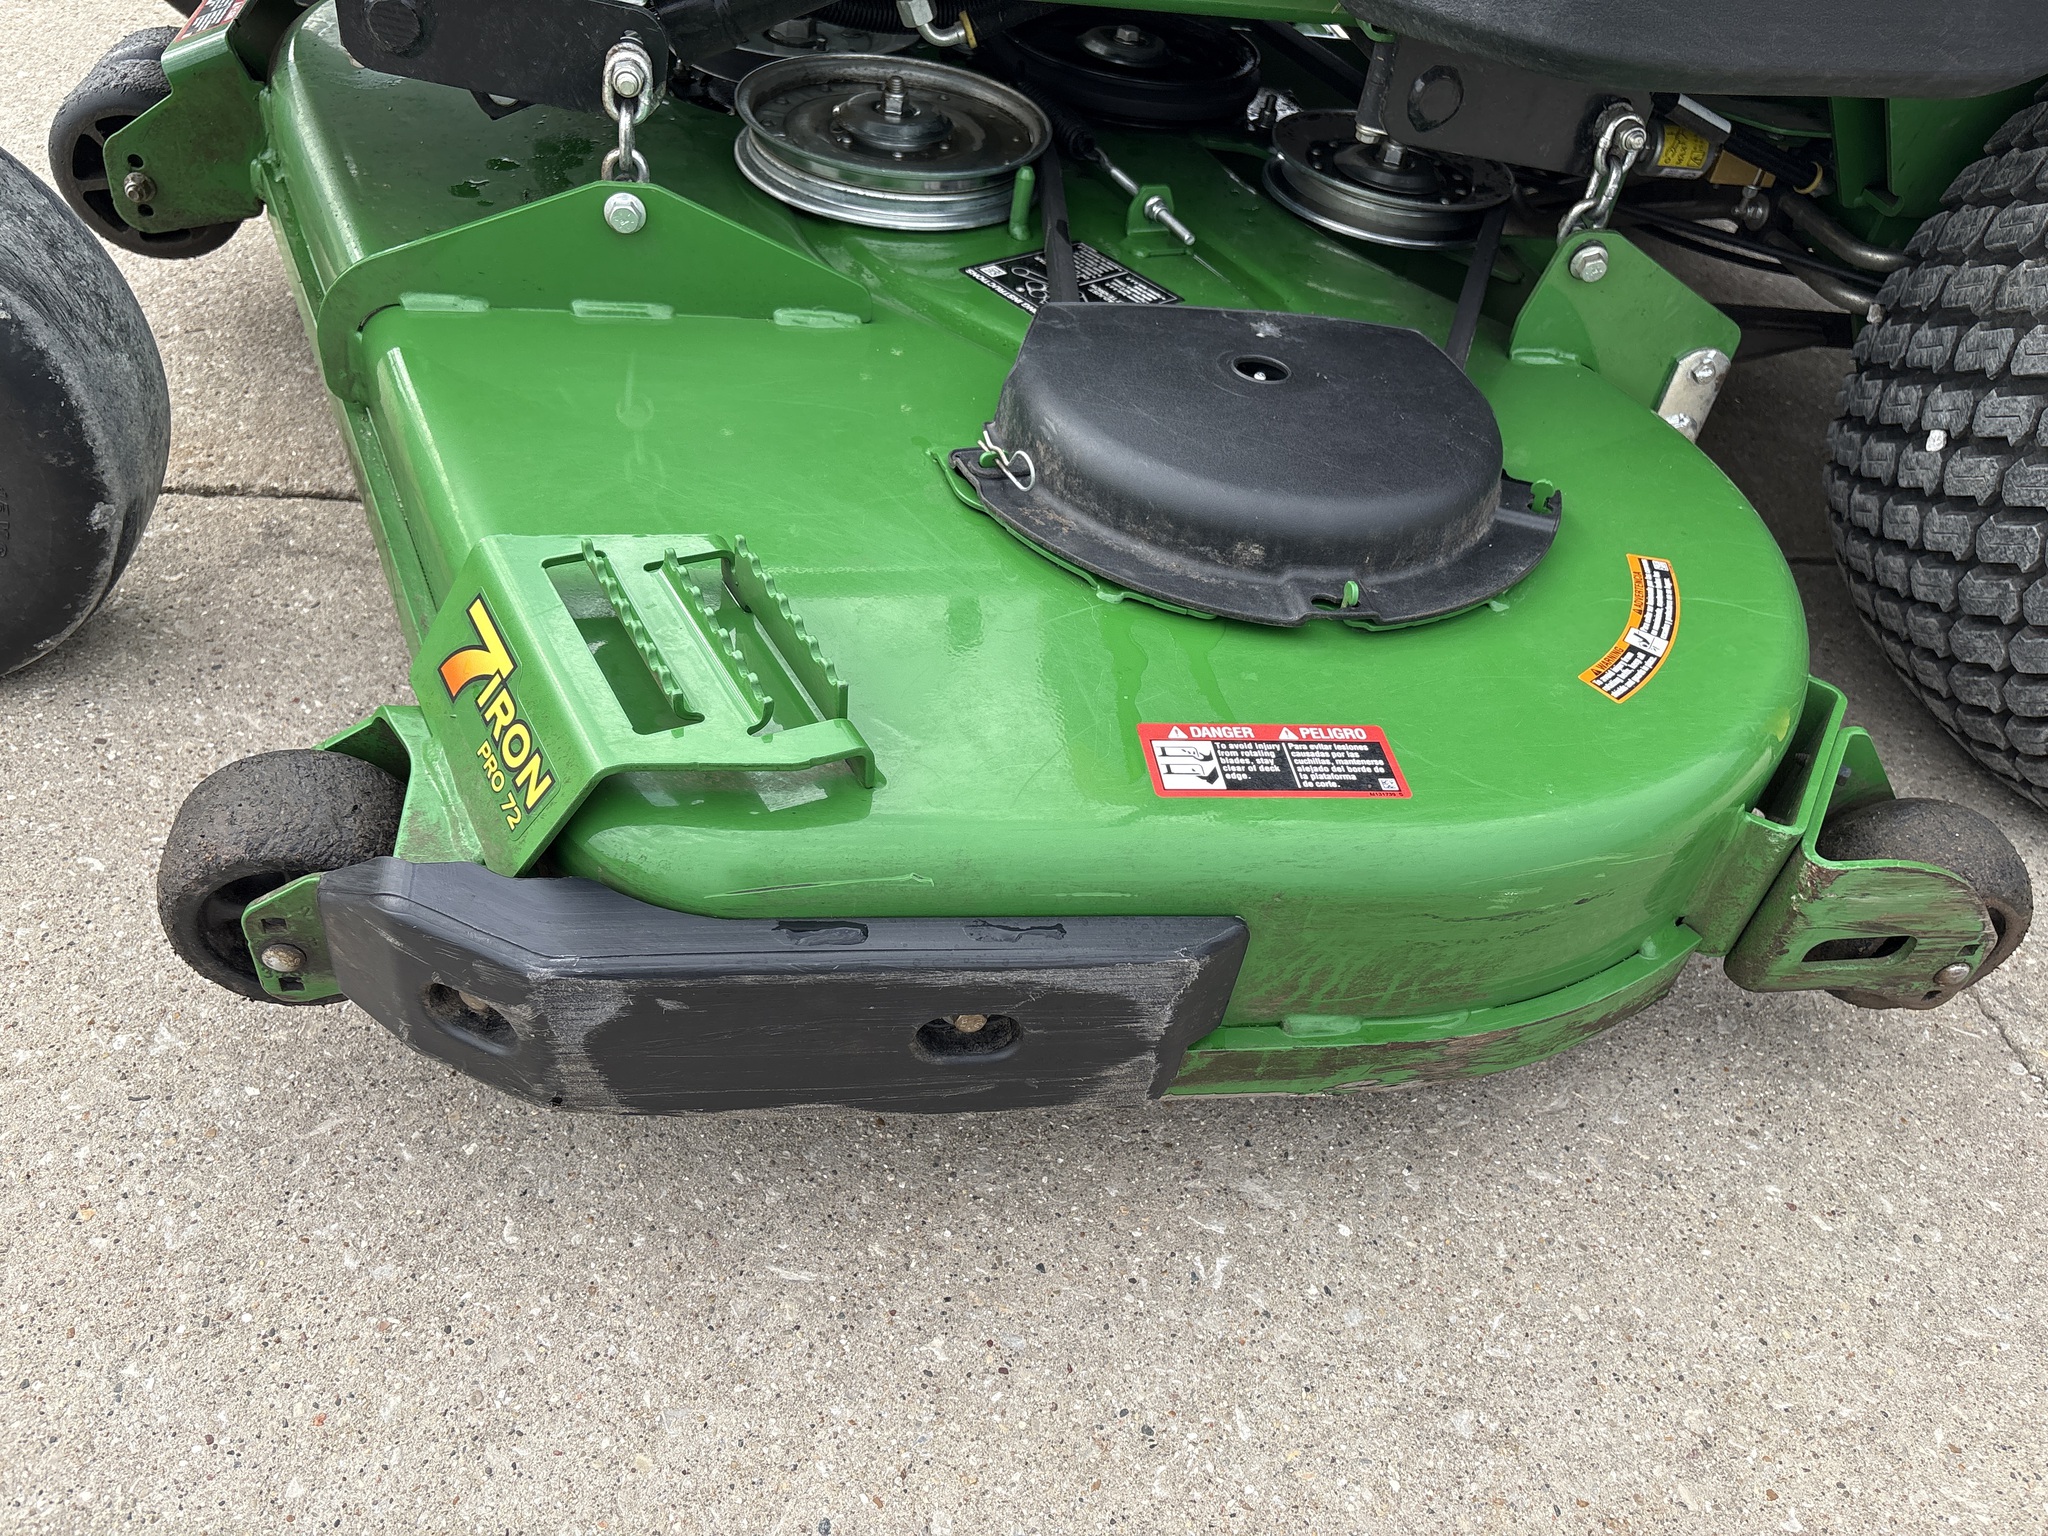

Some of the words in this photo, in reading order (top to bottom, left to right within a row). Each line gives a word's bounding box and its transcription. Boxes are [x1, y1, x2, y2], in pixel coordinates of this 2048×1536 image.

[964, 268, 1023, 304] INSTRUCTIONS
[1633, 571, 1644, 609] ADVERTENCIA
[1596, 646, 1624, 670] WARNING
[1189, 726, 1255, 739] DANGER
[1299, 727, 1367, 740] PELIGRO
[1214, 742, 1227, 750] To
[1229, 742, 1253, 750] avoid
[1255, 742, 1281, 751] injury
[1334, 743, 1369, 751] lesiones
[1241, 750, 1276, 758] rotating
[1293, 758, 1334, 766] cuchillas,
[1296, 765, 1330, 773] alejado
[1225, 772, 1252, 781] edge.
[1310, 773, 1357, 781] plataforma
[476, 739, 505, 793] PRO
[499, 791, 523, 832] 72
[1302, 780, 1314, 788] de
[1315, 780, 1341, 788] corte.
